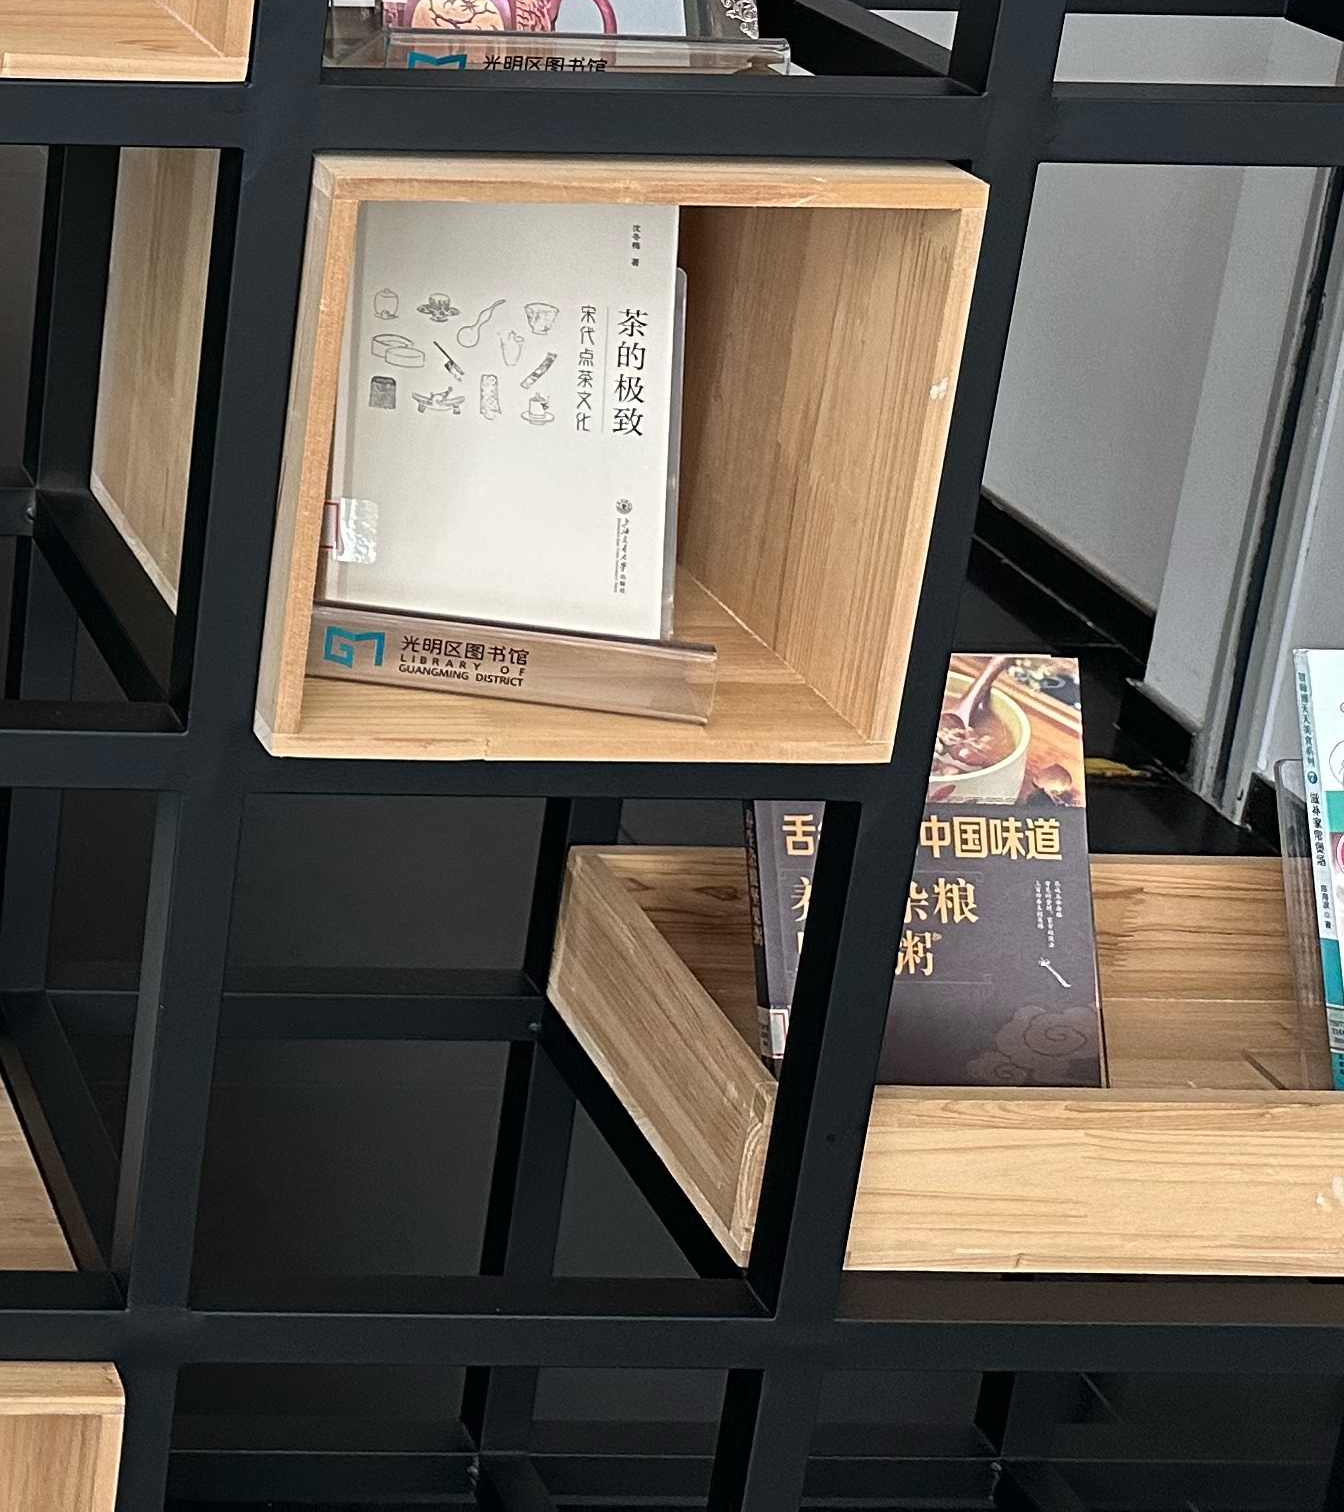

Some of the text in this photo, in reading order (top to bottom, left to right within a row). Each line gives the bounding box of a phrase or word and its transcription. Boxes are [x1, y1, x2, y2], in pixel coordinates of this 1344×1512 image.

[483, 54, 608, 72] 光明区图书馆
[575, 304, 597, 432] 宋代点茶文化
[612, 308, 649, 437] 茶的极致
[400, 653, 525, 676] LIBRARY OF
[401, 635, 530, 666] 光明区图书馆
[398, 663, 524, 687] GUANGMING DISTRICT
[920, 815, 1063, 863] 中国味道
